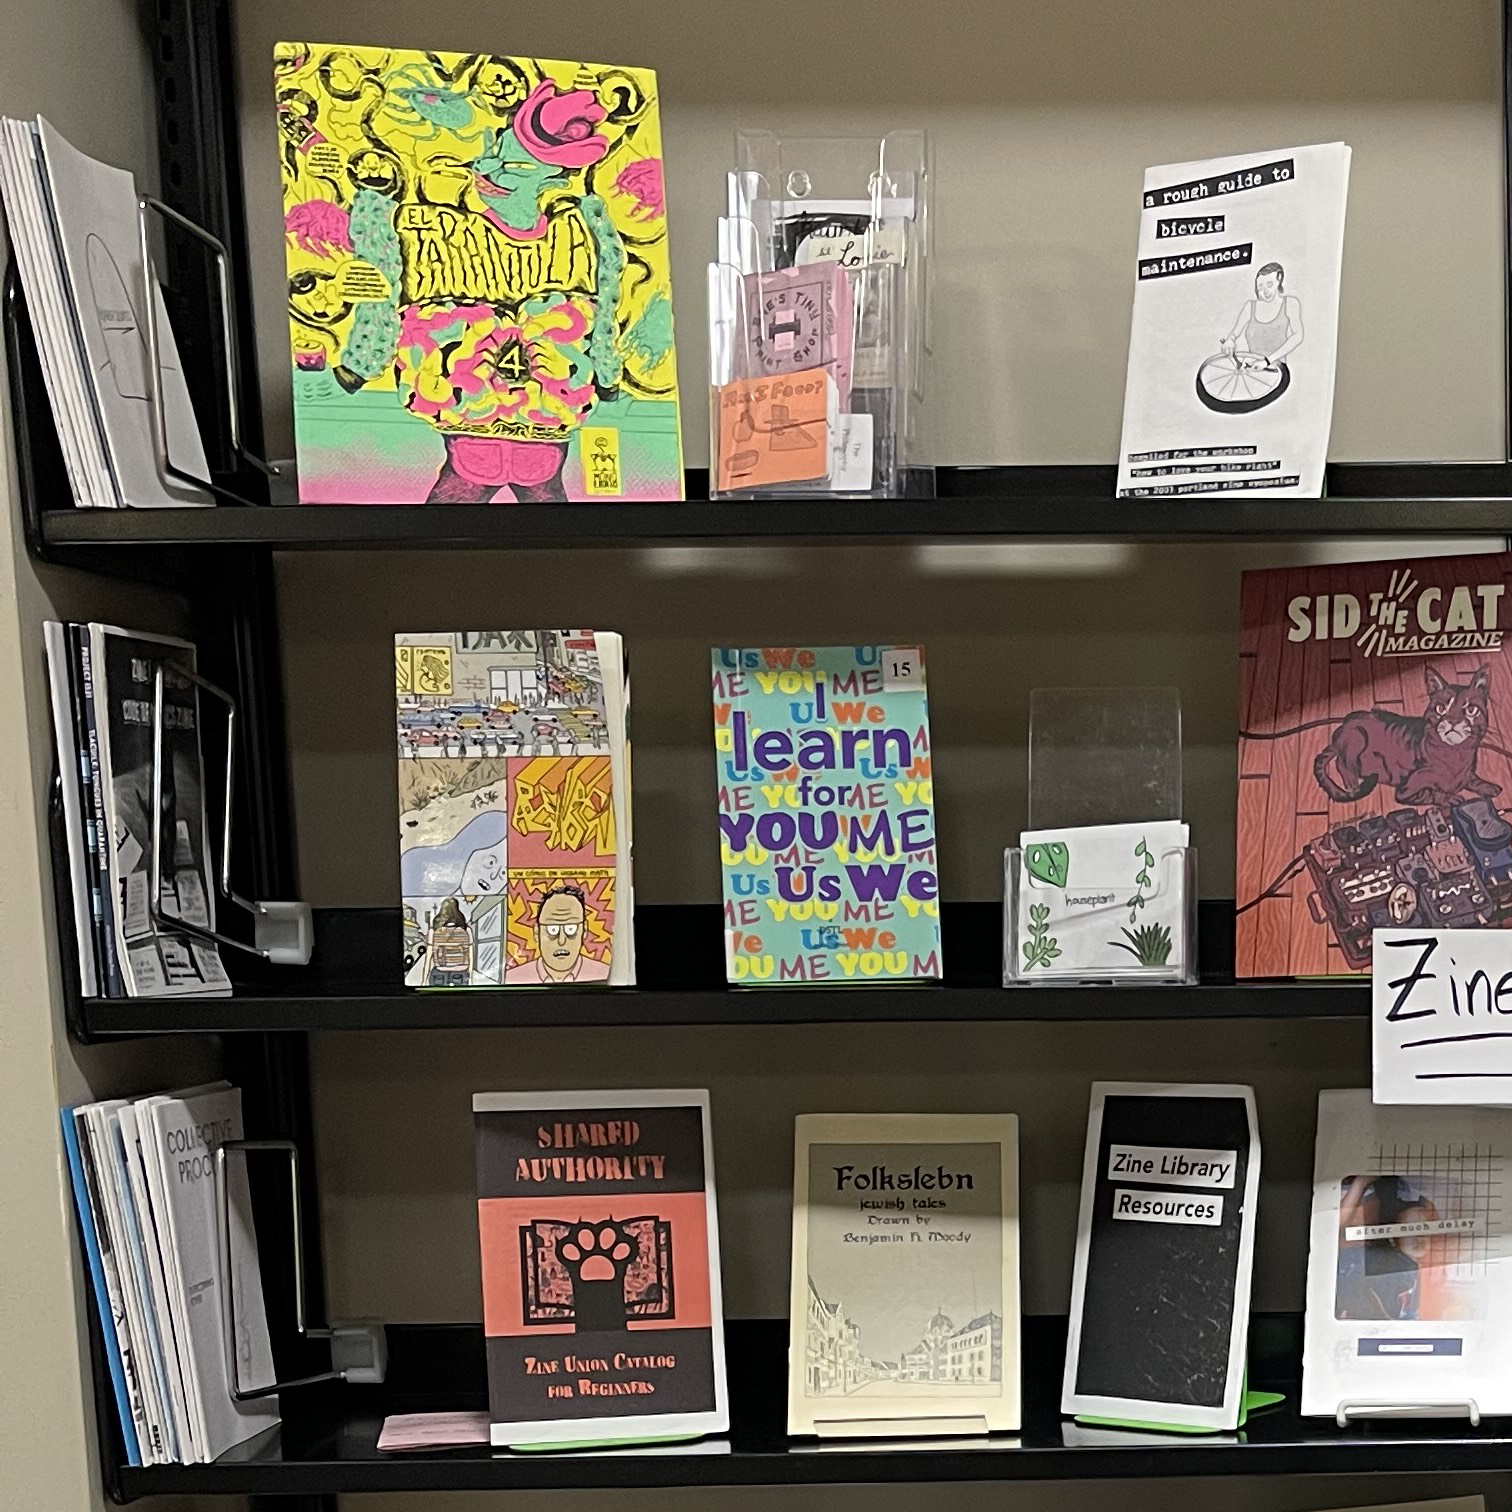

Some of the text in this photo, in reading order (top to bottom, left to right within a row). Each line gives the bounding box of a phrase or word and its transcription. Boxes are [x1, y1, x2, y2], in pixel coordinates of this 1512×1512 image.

[1145, 167, 1290, 207] a rough guide to
[407, 212, 432, 224] EL
[1161, 220, 1223, 237] bicycle
[411, 213, 598, 299] TARANTULA
[1141, 251, 1249, 277] maintenance.
[498, 350, 524, 377] 4
[1287, 585, 1504, 642] SID THE CAT
[1385, 630, 1504, 653] MAGAZINE
[892, 661, 911, 677] 15
[833, 668, 883, 698] ME
[832, 702, 885, 725] We
[732, 711, 912, 771] learn
[798, 775, 851, 806] for
[719, 809, 934, 855] YOU ME
[731, 873, 770, 895] Us
[775, 864, 937, 902] Us We
[844, 900, 894, 923] ME
[1065, 892, 1116, 908] houseplant
[843, 927, 897, 950] We
[780, 950, 908, 981] ME YOU
[167, 1119, 232, 1154] COLLECTIVE
[537, 1120, 640, 1149] SHARED
[516, 1155, 665, 1183] AUTHORITY
[833, 1165, 975, 1191] Folkslebn
[1113, 1153, 1231, 1183] Zine Library
[859, 1196, 946, 1211] jewish tales
[1118, 1194, 1215, 1219] Resources
[867, 1215, 931, 1226] Drawn by
[1356, 1218, 1475, 1237] after much delay
[843, 1232, 972, 1245] Benjamin Moody
